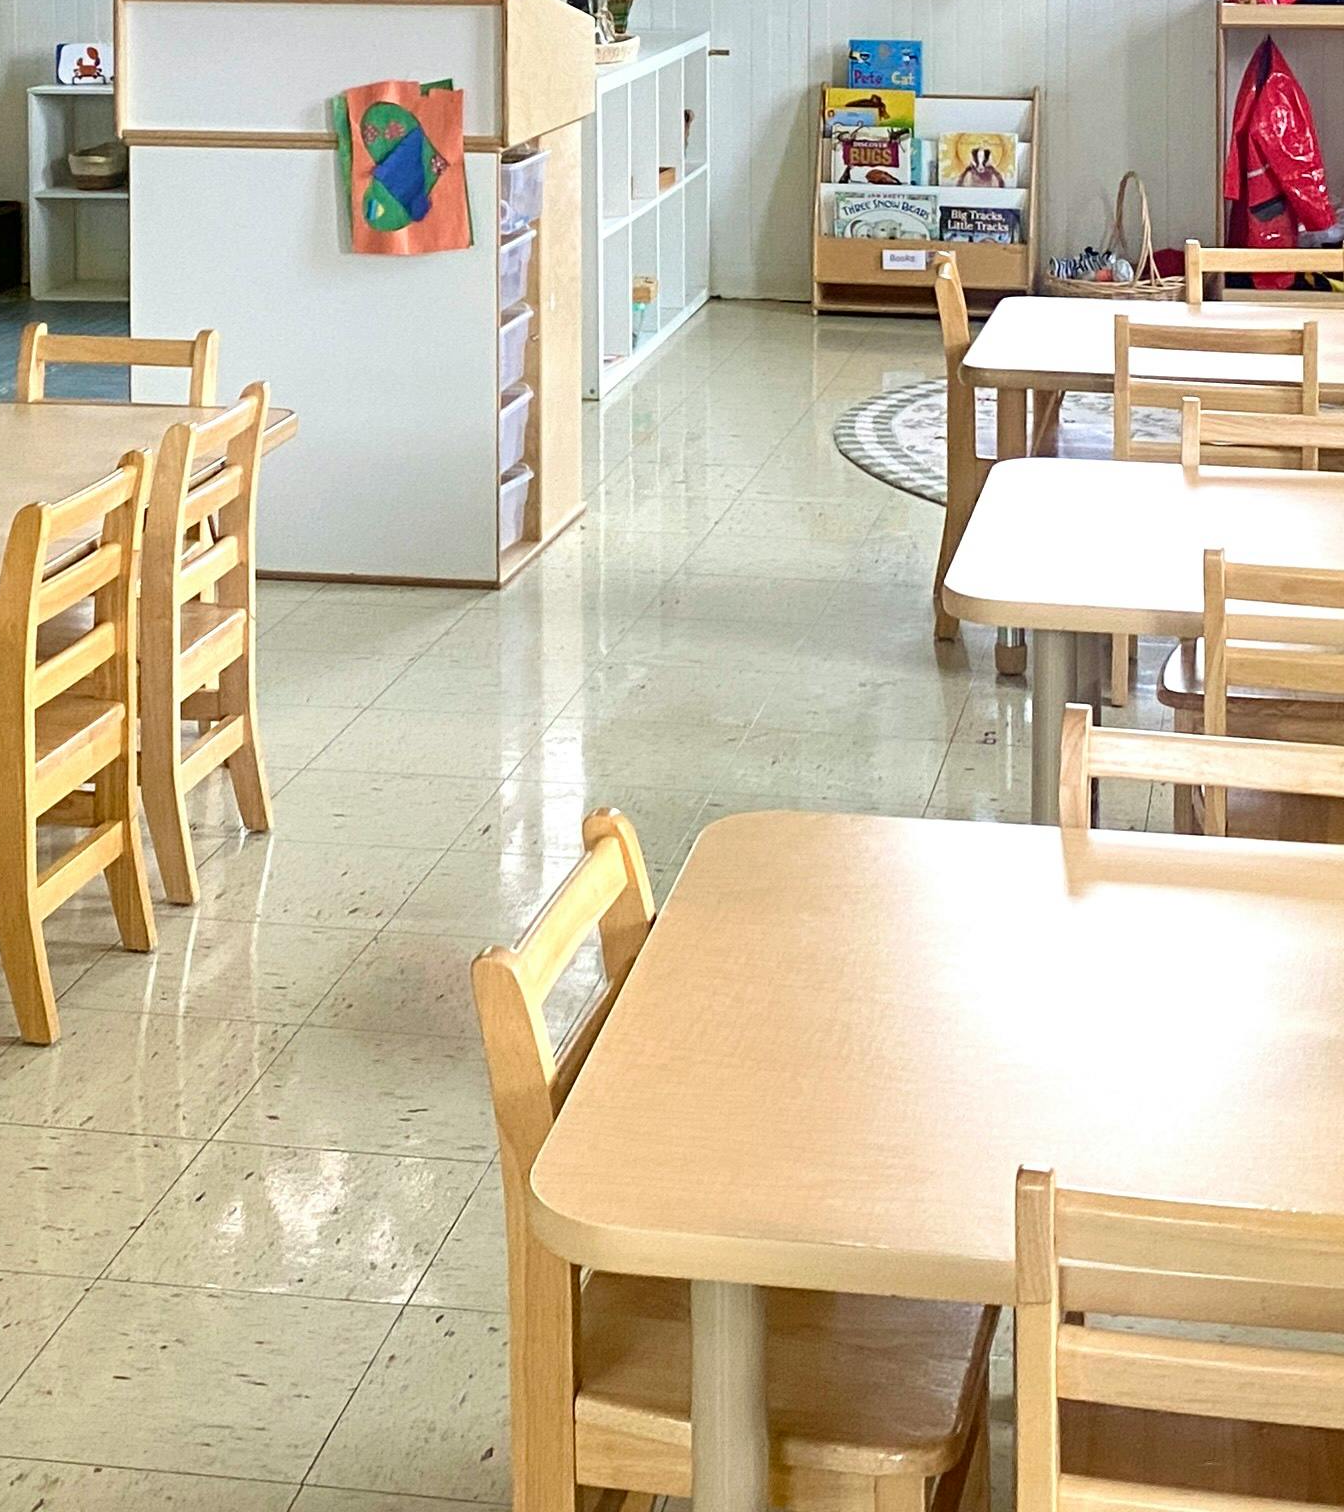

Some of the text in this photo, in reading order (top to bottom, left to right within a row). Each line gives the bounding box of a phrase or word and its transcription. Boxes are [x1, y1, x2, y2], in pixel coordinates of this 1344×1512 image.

[891, 71, 915, 85] Cat
[849, 148, 893, 165] BUGS
[842, 199, 930, 220] THREE SNOW BEARS
[951, 209, 1006, 222] Big Tracks,
[947, 220, 1009, 232] Little Tracks
[889, 254, 916, 263] Books
